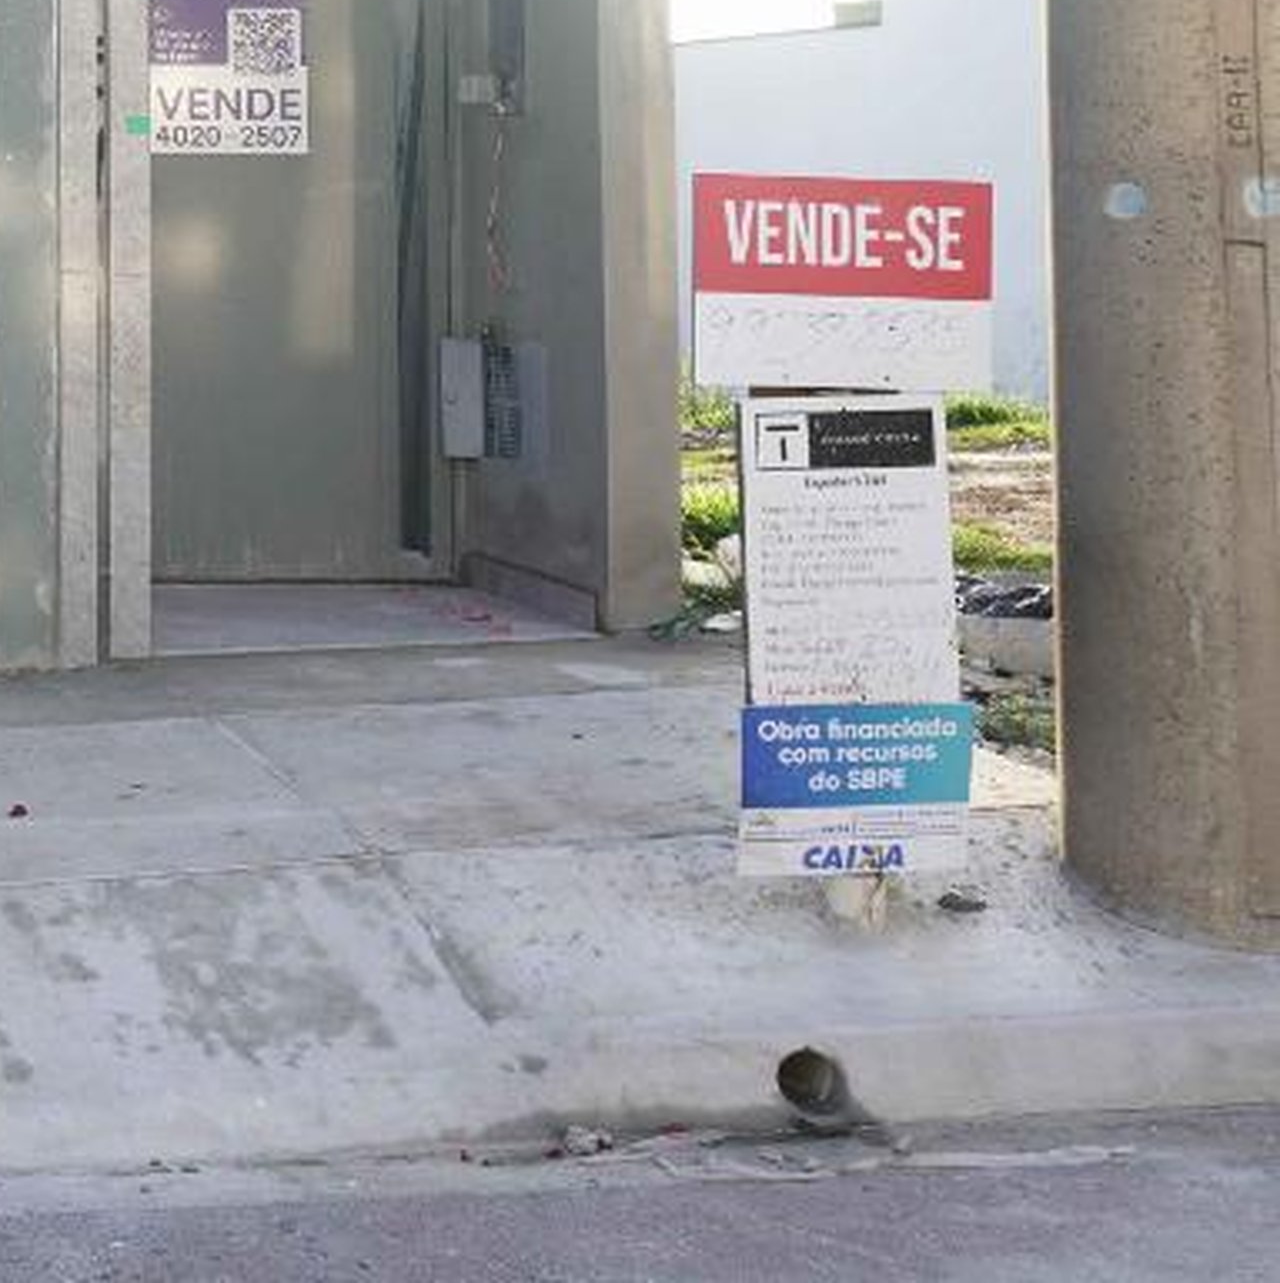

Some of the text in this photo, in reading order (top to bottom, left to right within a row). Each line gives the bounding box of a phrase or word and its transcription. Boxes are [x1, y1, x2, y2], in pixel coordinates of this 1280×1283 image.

[156, 88, 302, 120] VENDE
[724, 199, 966, 271] VENDE-SE
[757, 716, 958, 742] Obra financiada
[778, 743, 939, 766] com recursos
[808, 767, 907, 792] do SBPE
